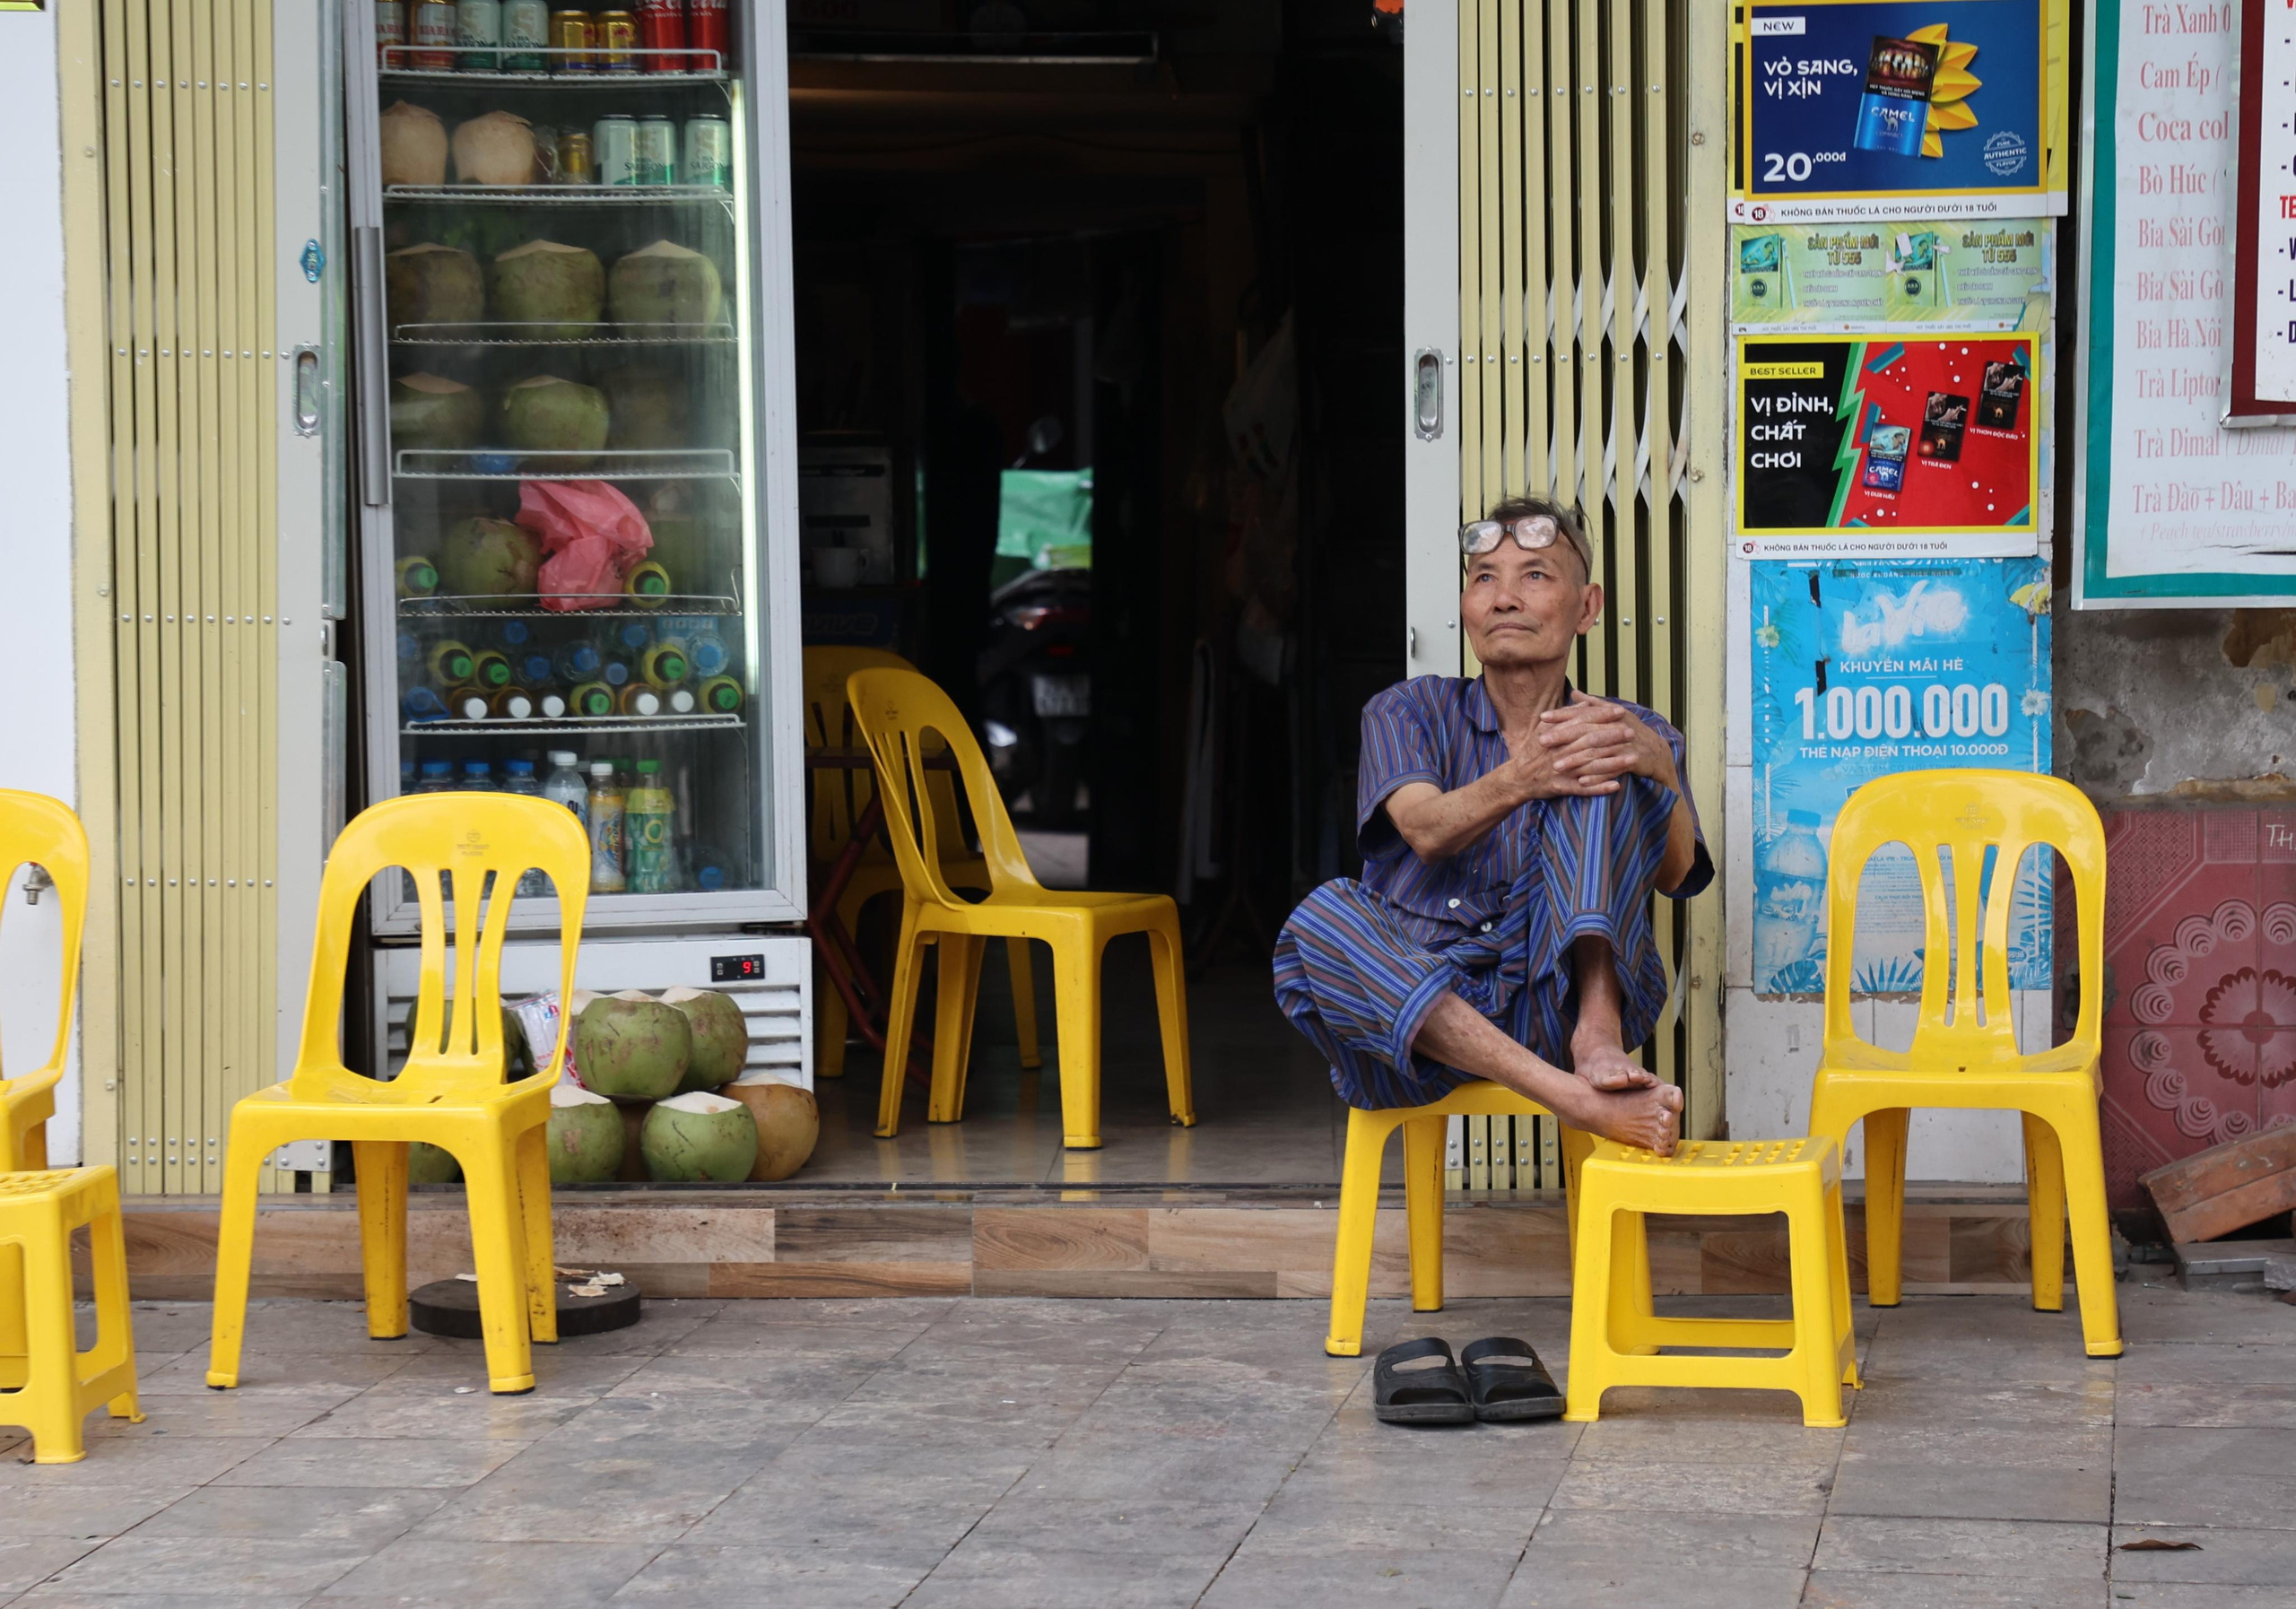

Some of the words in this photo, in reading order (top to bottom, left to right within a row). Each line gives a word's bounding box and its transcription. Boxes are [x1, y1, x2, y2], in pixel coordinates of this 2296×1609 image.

[1763, 22, 1795, 31] NEW
[2142, 4, 2170, 34] Trà
[2176, 4, 2217, 34] Xanh
[1763, 56, 1792, 76] VỎ
[1797, 59, 1858, 77] SANG,
[2141, 61, 2179, 89] Cam
[2187, 51, 2211, 95] Ép
[1763, 77, 1783, 100] VỊ
[1787, 76, 1822, 100] XỊN
[1871, 106, 1915, 123] CAMEL
[2138, 111, 2191, 142] Coca
[2199, 110, 2230, 141] col
[1984, 147, 2027, 161] AUTHENTIC
[2139, 163, 2163, 195] Bò
[2170, 162, 2206, 194] Húc
[1781, 206, 1813, 217] KHÔNG
[1815, 206, 1835, 216] BÁN
[1837, 204, 1866, 216] THUỐC
[1869, 205, 1881, 214] LÁ
[1883, 205, 1902, 214] CHO
[1904, 204, 1935, 214] NGƯỜI
[1937, 203, 1962, 213] DƯỚI
[1965, 204, 1974, 213] 18
[1977, 203, 1997, 213] TUỔI
[2138, 218, 2163, 248] Bia
[2169, 217, 2193, 248] Sài
[2137, 270, 2163, 301] Bia
[2169, 270, 2194, 300] Sài
[2200, 269, 2224, 300] Gò
[2136, 319, 2161, 349] Bia
[2168, 318, 2189, 348] Hà
[2196, 317, 2222, 356] Nội
[1779, 367, 1816, 375] SELLER
[2135, 369, 2165, 398] Trà
[1751, 396, 1770, 417] VỊ
[1776, 392, 1834, 414] ĐỈNH,
[1751, 420, 1806, 440] CHẤT
[2135, 428, 2163, 458] Trà
[2170, 427, 2220, 457] Dimal
[1751, 451, 1801, 468] CHƠI
[1869, 465, 1899, 477] CAMEL
[2133, 483, 2161, 513] Trà
[2167, 482, 2200, 512] Đào
[2221, 481, 2254, 511] Dâu
[2275, 481, 2296, 517] Bạ
[1764, 542, 1791, 551] KHÔNG
[1793, 543, 1809, 551] BÁN
[1811, 541, 1837, 551] THUỐC
[1839, 543, 1848, 551] LÁ
[1849, 543, 1866, 551] CHO
[1868, 542, 1895, 551] NGƯỜI
[1897, 542, 1918, 551] DƯỚI
[1930, 541, 1948, 550] TUỔI
[1795, 683, 2008, 740] 1.000.000
[1831, 746, 1861, 761] NẠP
[1864, 744, 1899, 760] ĐIỆN
[1901, 744, 1947, 760] THOẠI
[1950, 744, 2009, 756] 10.000Đ
[743, 961, 752, 973] 9
